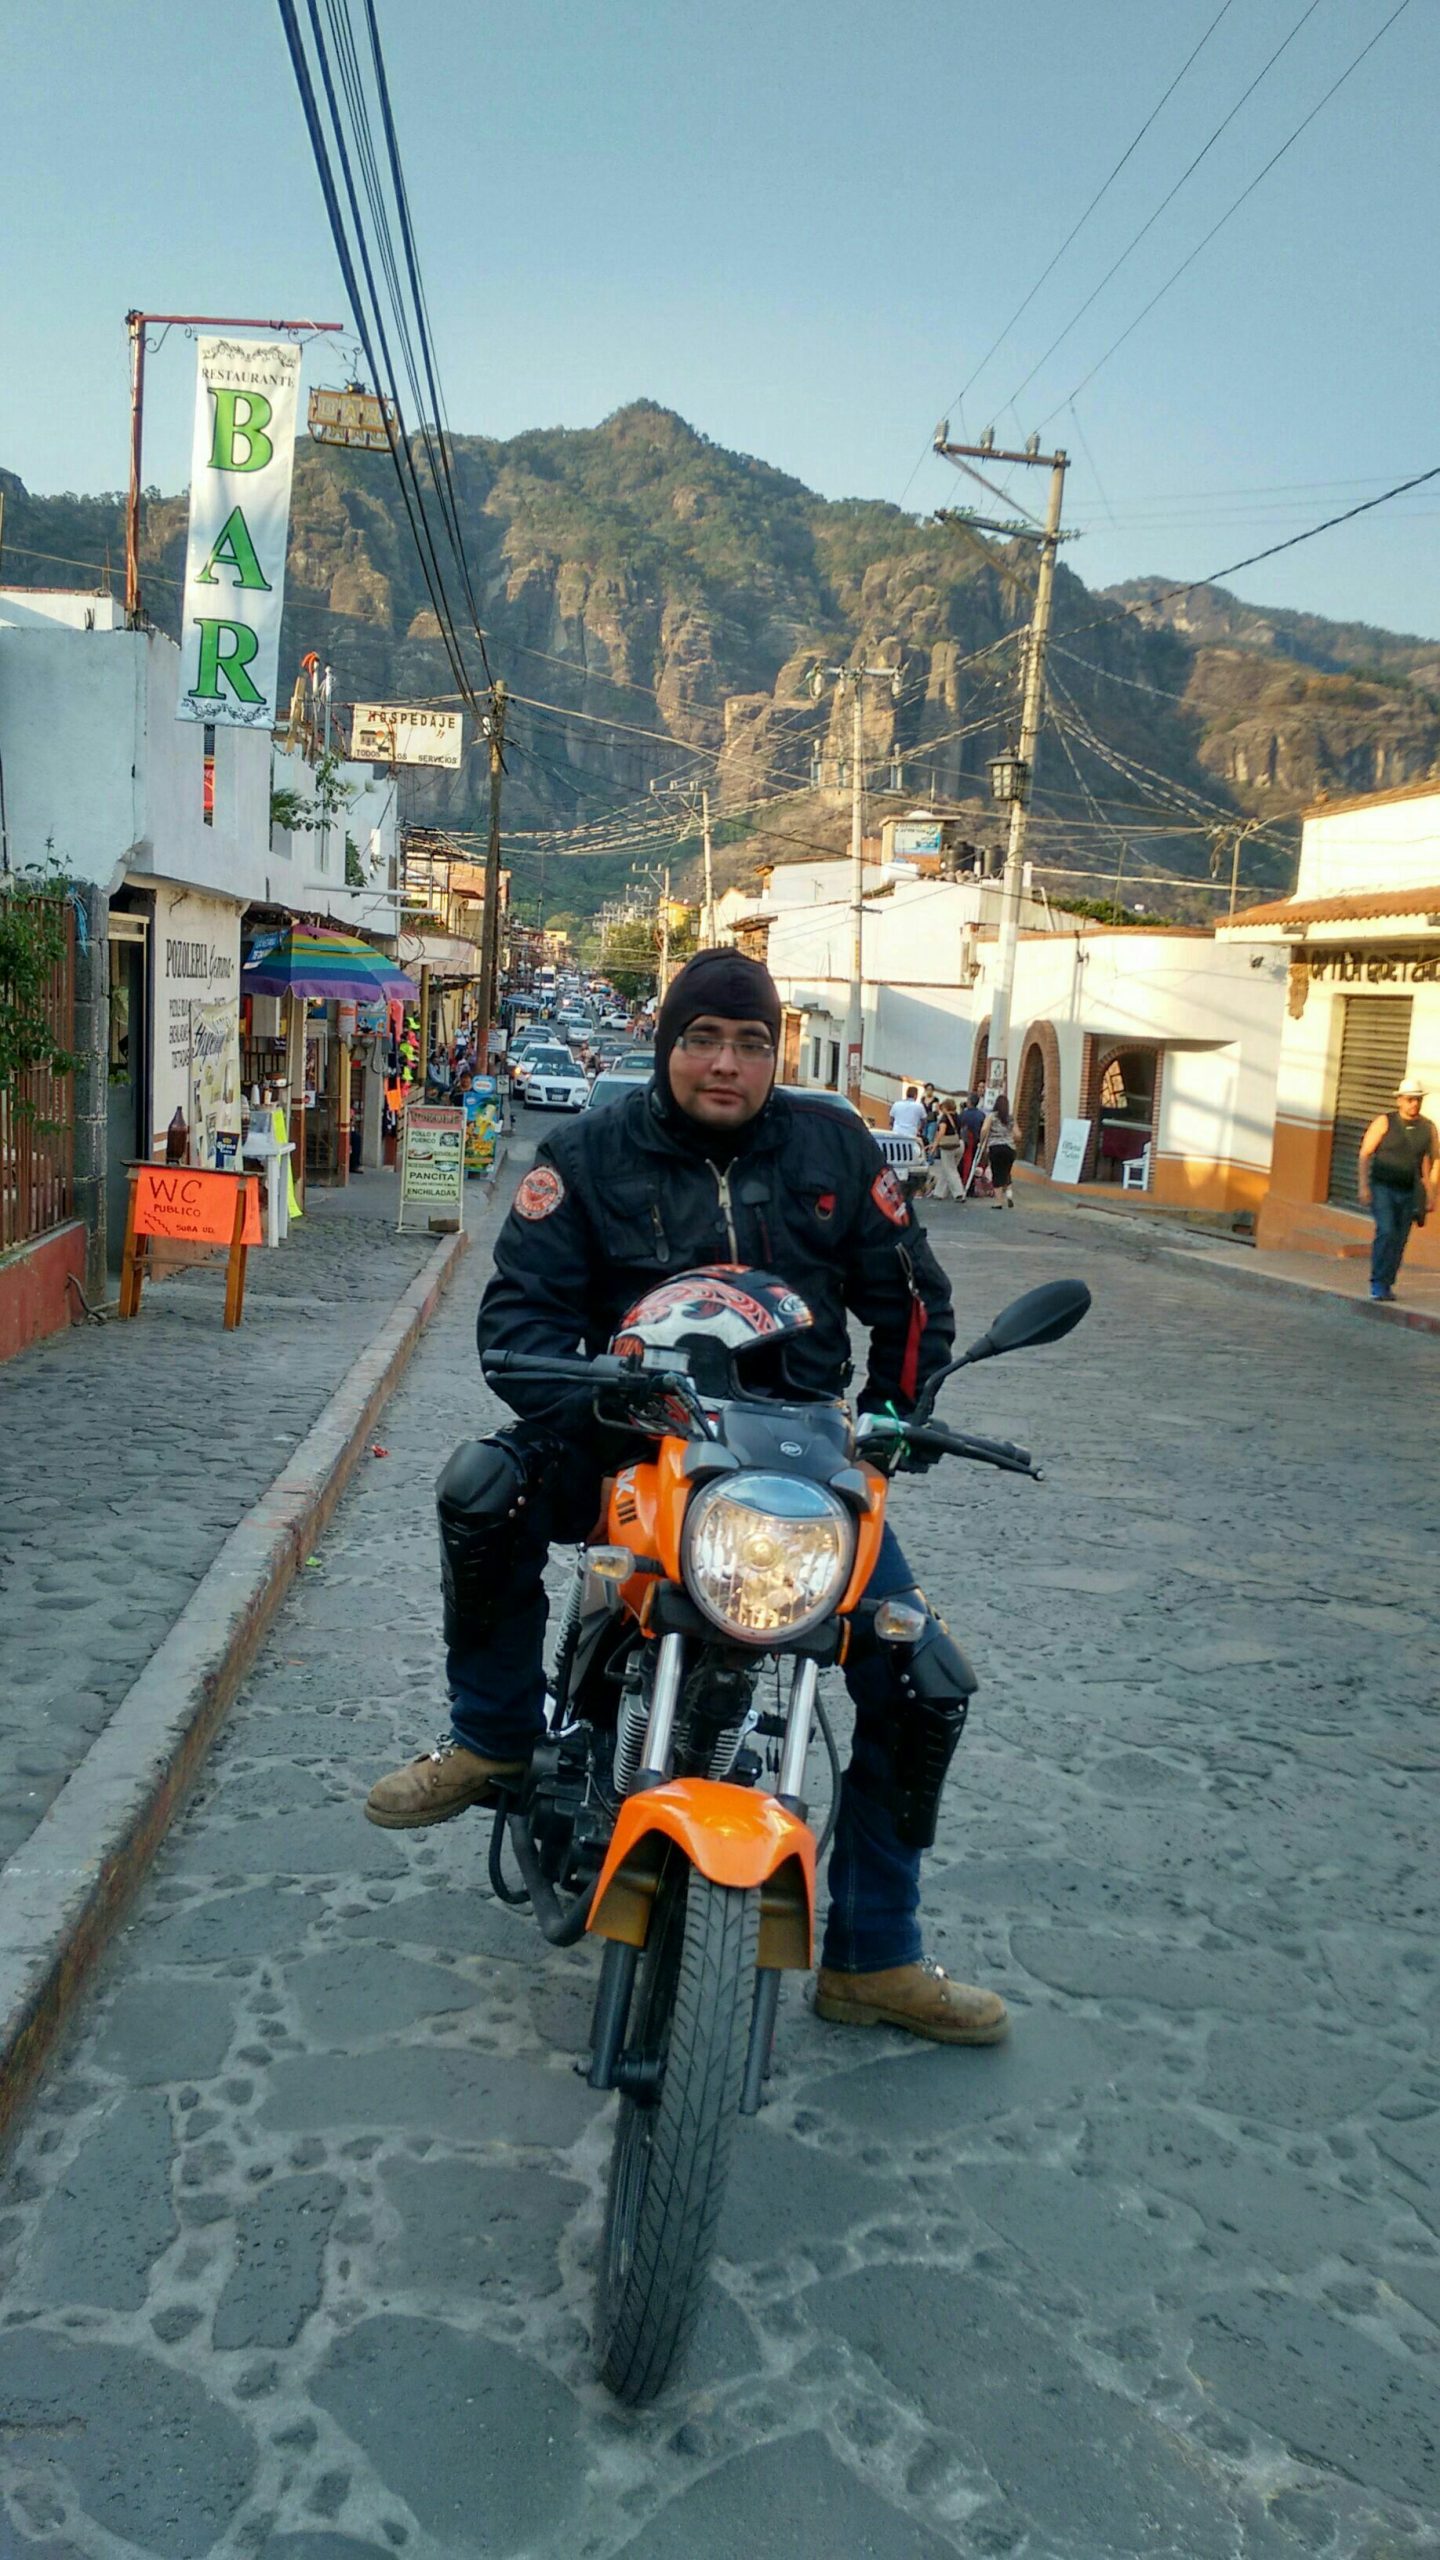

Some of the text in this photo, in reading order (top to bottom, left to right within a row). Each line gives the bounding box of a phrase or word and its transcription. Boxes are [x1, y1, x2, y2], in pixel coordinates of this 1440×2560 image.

[202, 368, 295, 388] RESTAURANTE
[188, 386, 273, 705] BAR
[367, 710, 456, 729] HOSPEDAJE
[356, 749, 381, 758] TODOS
[418, 754, 457, 764] SERVICIOS
[165, 939, 208, 979] POZOLERIA
[409, 1172, 455, 1181] PANCITA
[149, 1177, 202, 1204] WC
[407, 1188, 457, 1197] ENCHILADAS
[153, 1204, 201, 1217] PUBLICO
